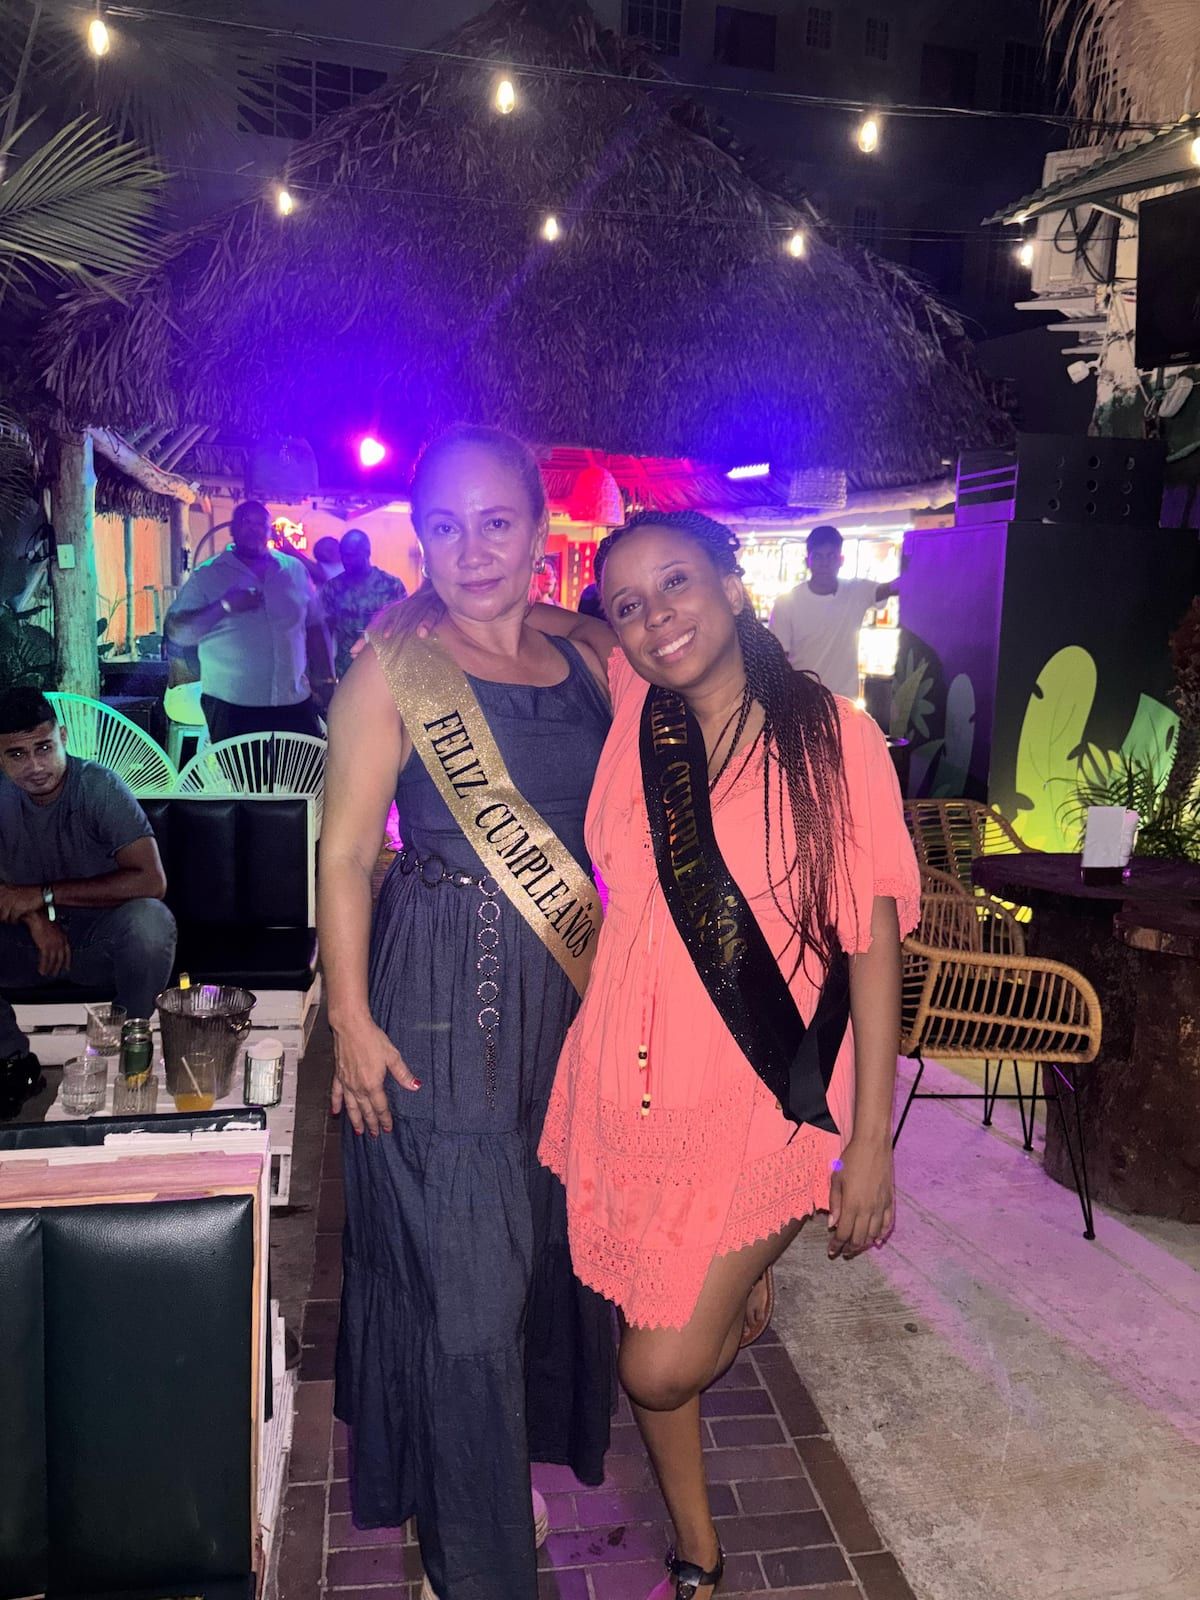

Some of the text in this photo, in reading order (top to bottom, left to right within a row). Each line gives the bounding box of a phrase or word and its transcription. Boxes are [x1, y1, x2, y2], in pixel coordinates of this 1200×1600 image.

[651, 688, 688, 755] ELIZ
[424, 709, 596, 958] FELIZ CUMPLEAÑOS
